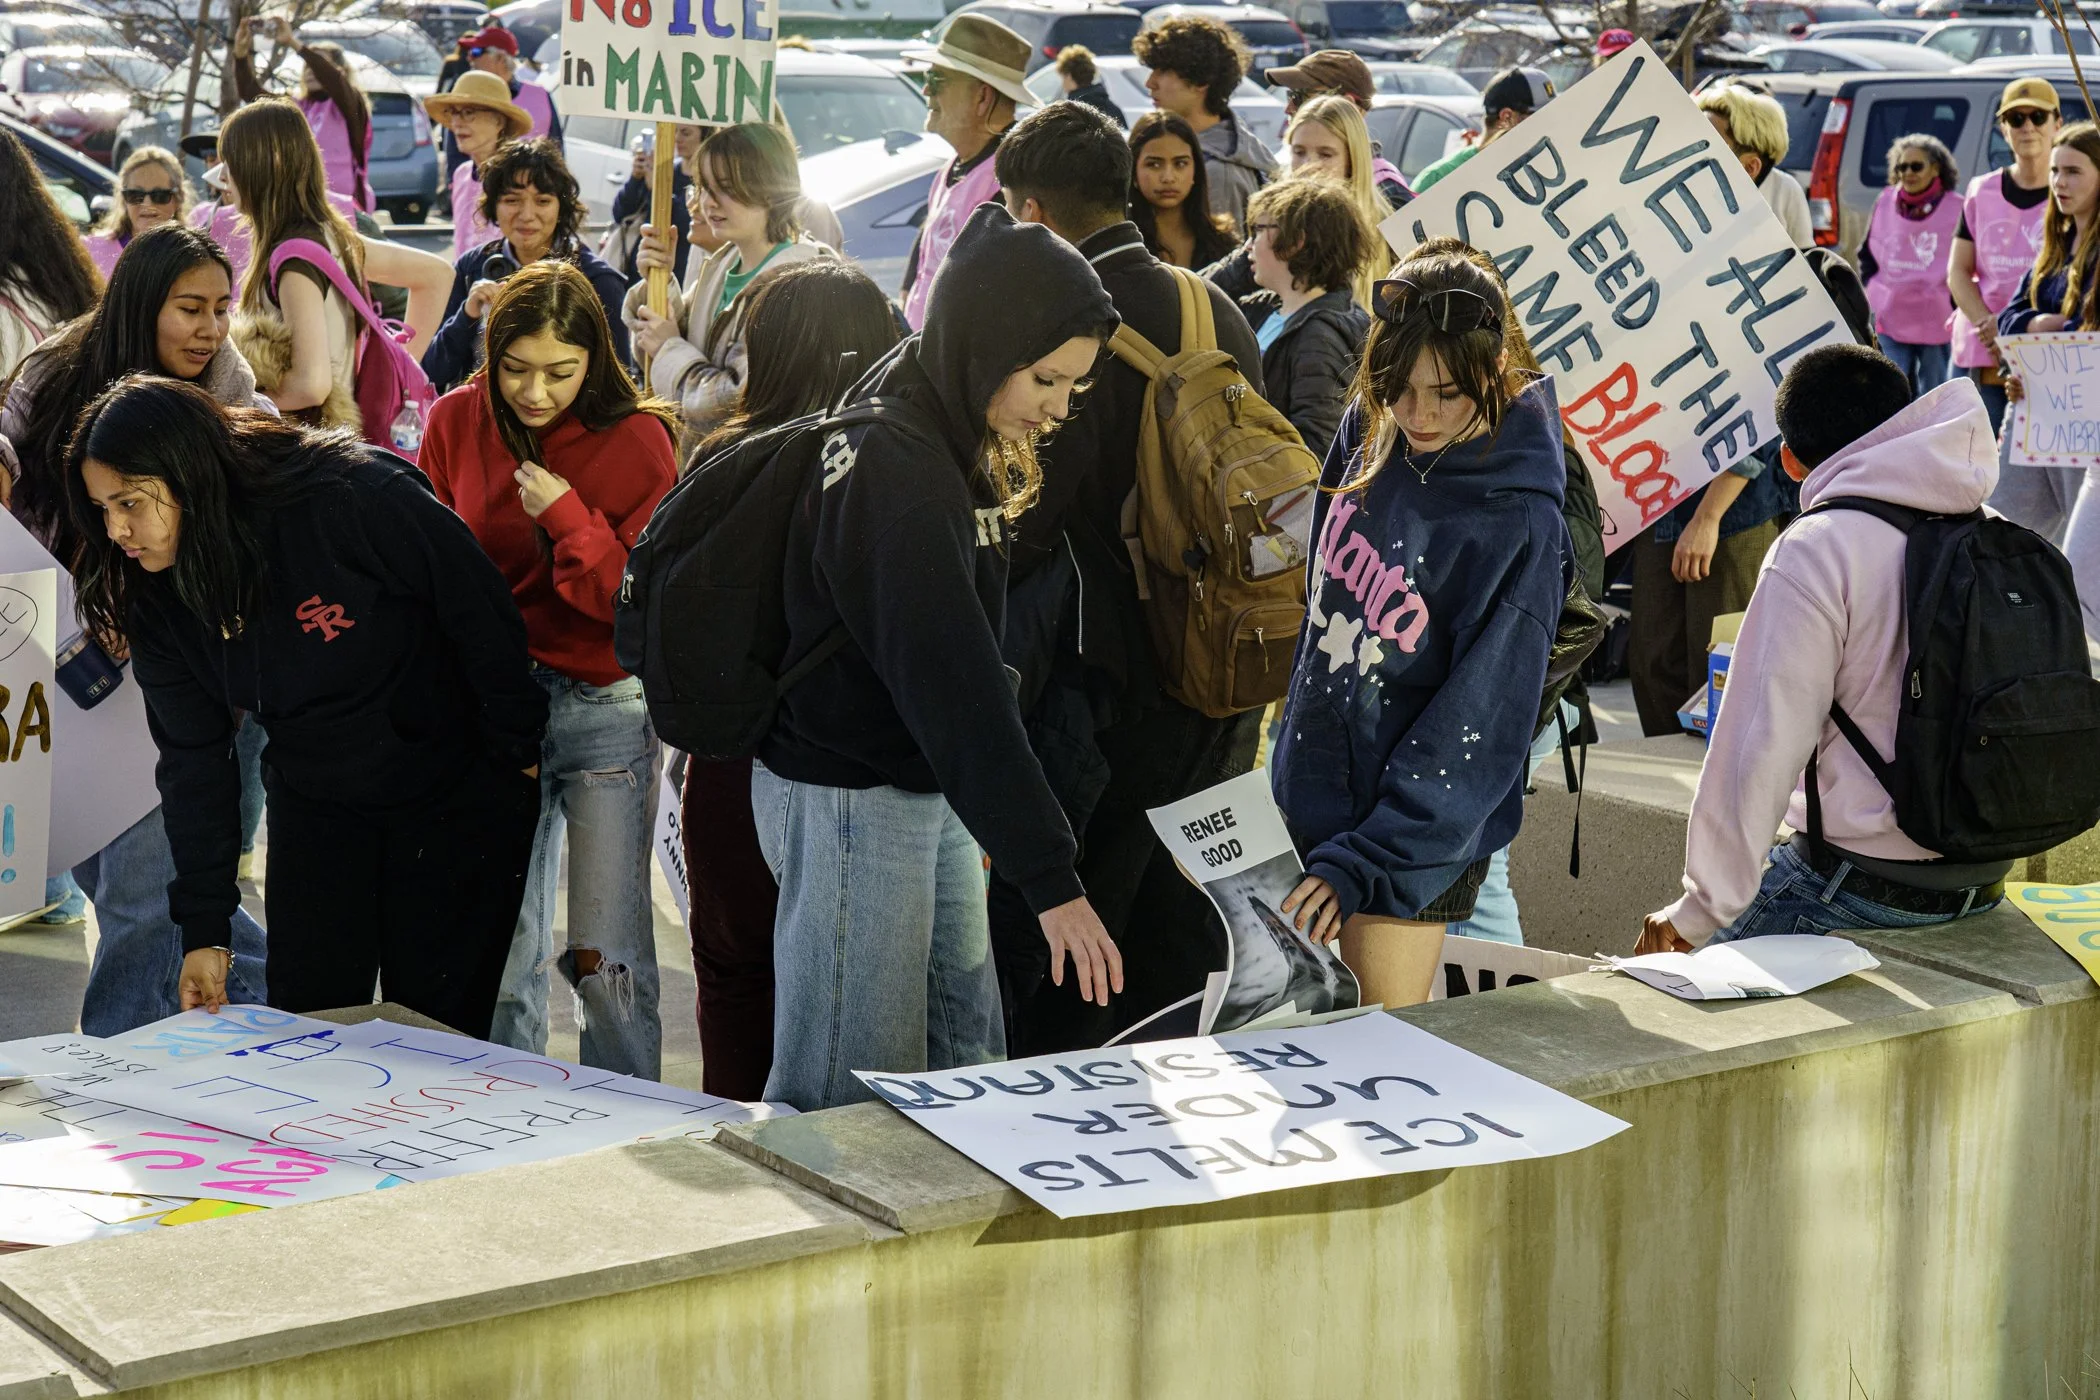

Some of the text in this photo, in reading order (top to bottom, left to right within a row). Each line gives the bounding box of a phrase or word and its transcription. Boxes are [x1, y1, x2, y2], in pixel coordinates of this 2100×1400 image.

[668, 0, 773, 41] ICE
[563, 43, 773, 124] in MARIN
[1580, 56, 1836, 388] WE ALL
[1497, 136, 1759, 473] BLEED THE
[2018, 343, 2100, 377] UNI
[2045, 383, 2084, 411] WE
[2032, 419, 2100, 454] UNBR
[296, 594, 356, 642] SR
[1180, 806, 1238, 844] RENEE
[1201, 838, 1243, 868] GOOD
[172, 1037, 490, 1114] ICE
[571, 1079, 725, 1115] I
[269, 1060, 571, 1145] CRUSHED
[331, 1100, 611, 1172] PREFER
[1018, 1112, 1525, 1192] ICE MELTS
